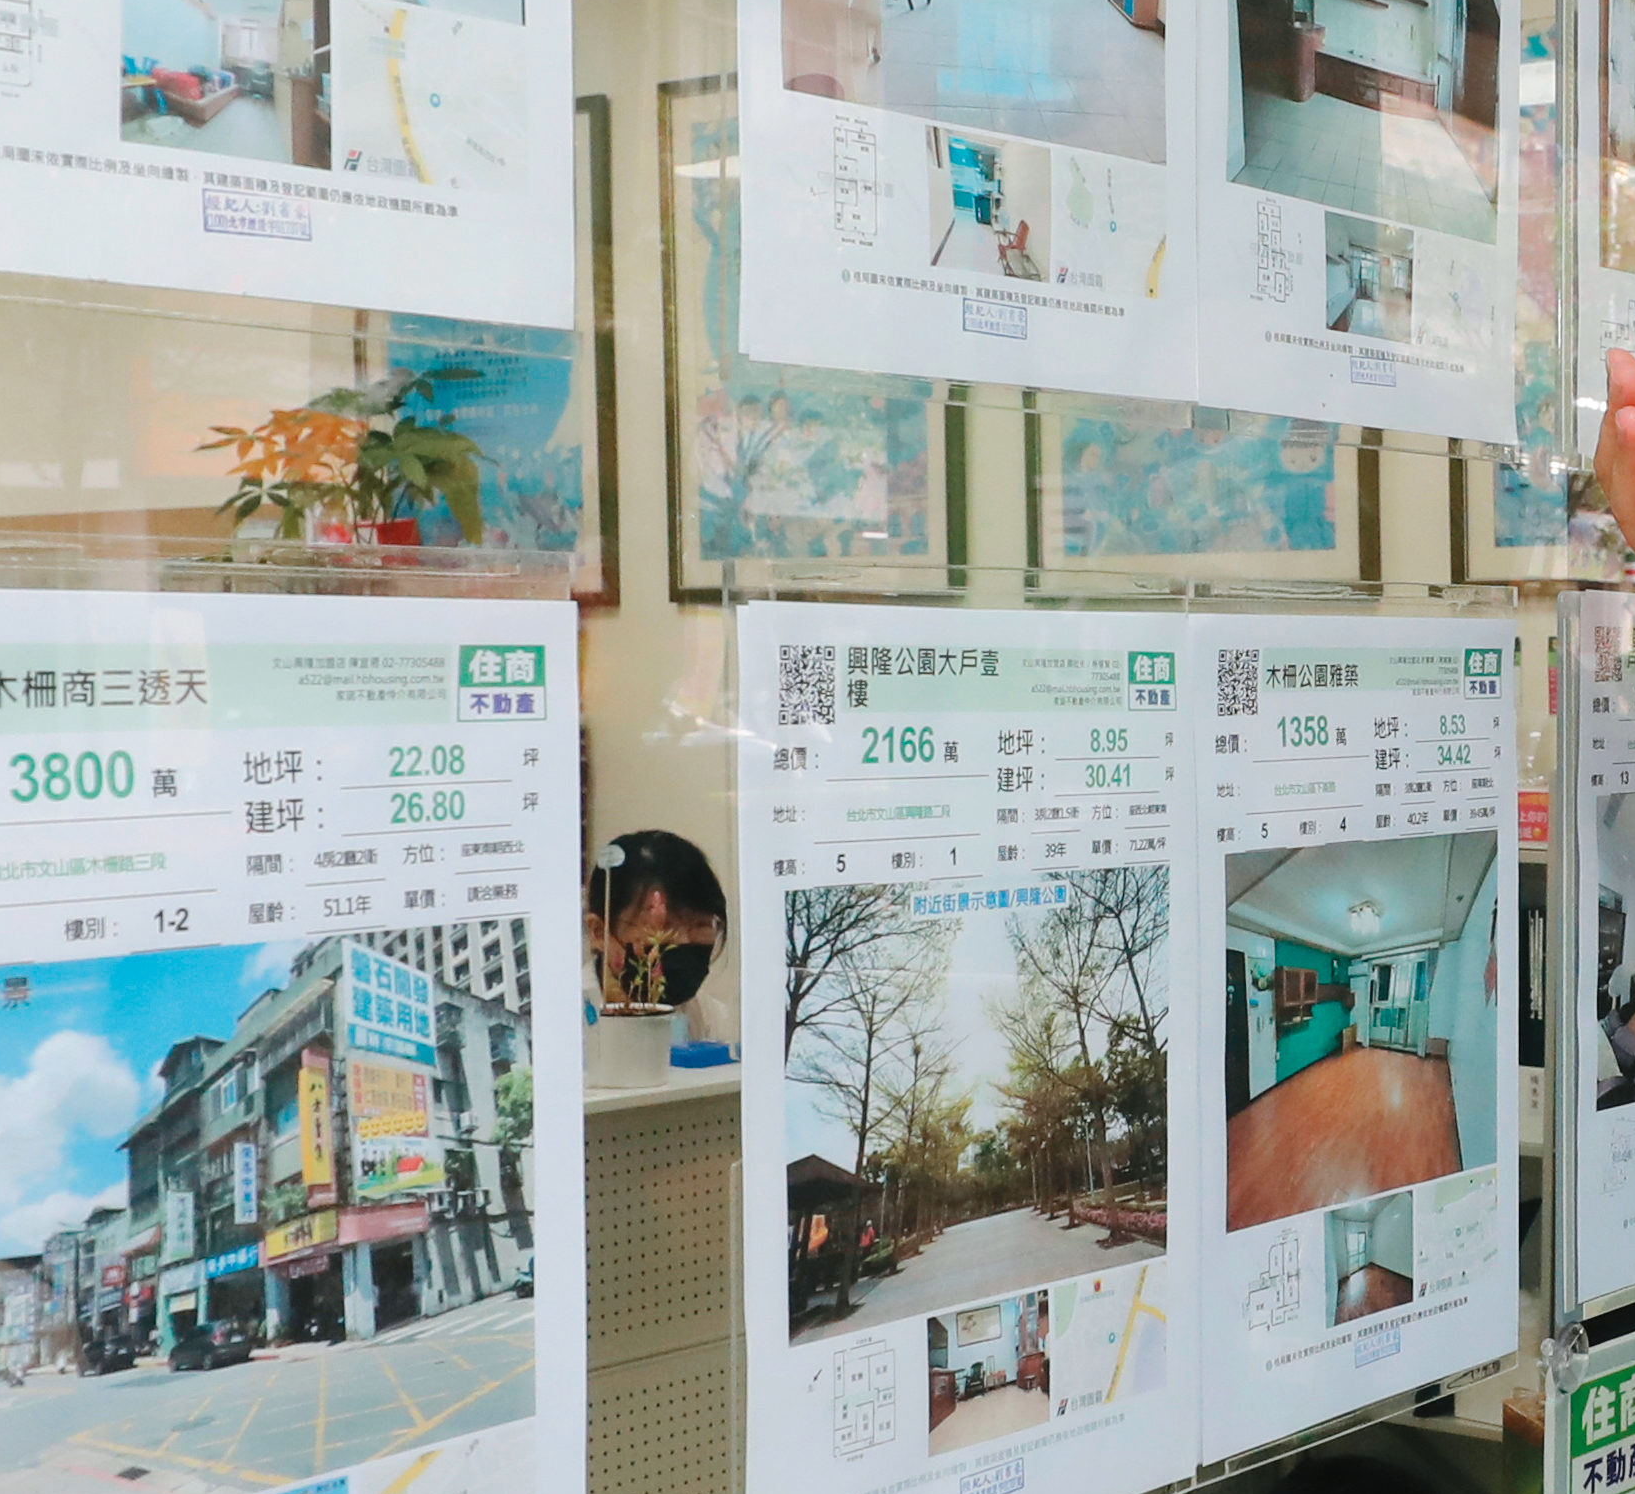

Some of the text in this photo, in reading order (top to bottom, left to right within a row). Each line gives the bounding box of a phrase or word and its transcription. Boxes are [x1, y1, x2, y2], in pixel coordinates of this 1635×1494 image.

[468, 649, 537, 684] 住商
[847, 647, 1000, 677] 興隆公園大戶壹
[1133, 655, 1172, 682] 住商
[1468, 651, 1498, 674] 住商
[1266, 663, 1359, 688] 木柵公園雅築
[1469, 680, 1497, 695] 不動產
[470, 692, 536, 714] 不動產
[847, 678, 869, 708] 樓
[1135, 688, 1171, 707] 不動產
[1278, 715, 1347, 748] 1358 萬
[1440, 714, 1466, 735] 8.53
[862, 725, 959, 765] 2166 萬
[1090, 728, 1128, 754] 8.95
[388, 744, 540, 778] 22.08 坪
[1437, 745, 1471, 766] 34.42
[9, 750, 178, 803] 3800 萬
[1085, 763, 1132, 789] 30.41
[1619, 770, 1630, 785] 13
[390, 790, 540, 825] 26.80 坪
[1261, 817, 1347, 839] 5 4
[836, 847, 957, 873] 5 1
[153, 907, 190, 934] 1-2
